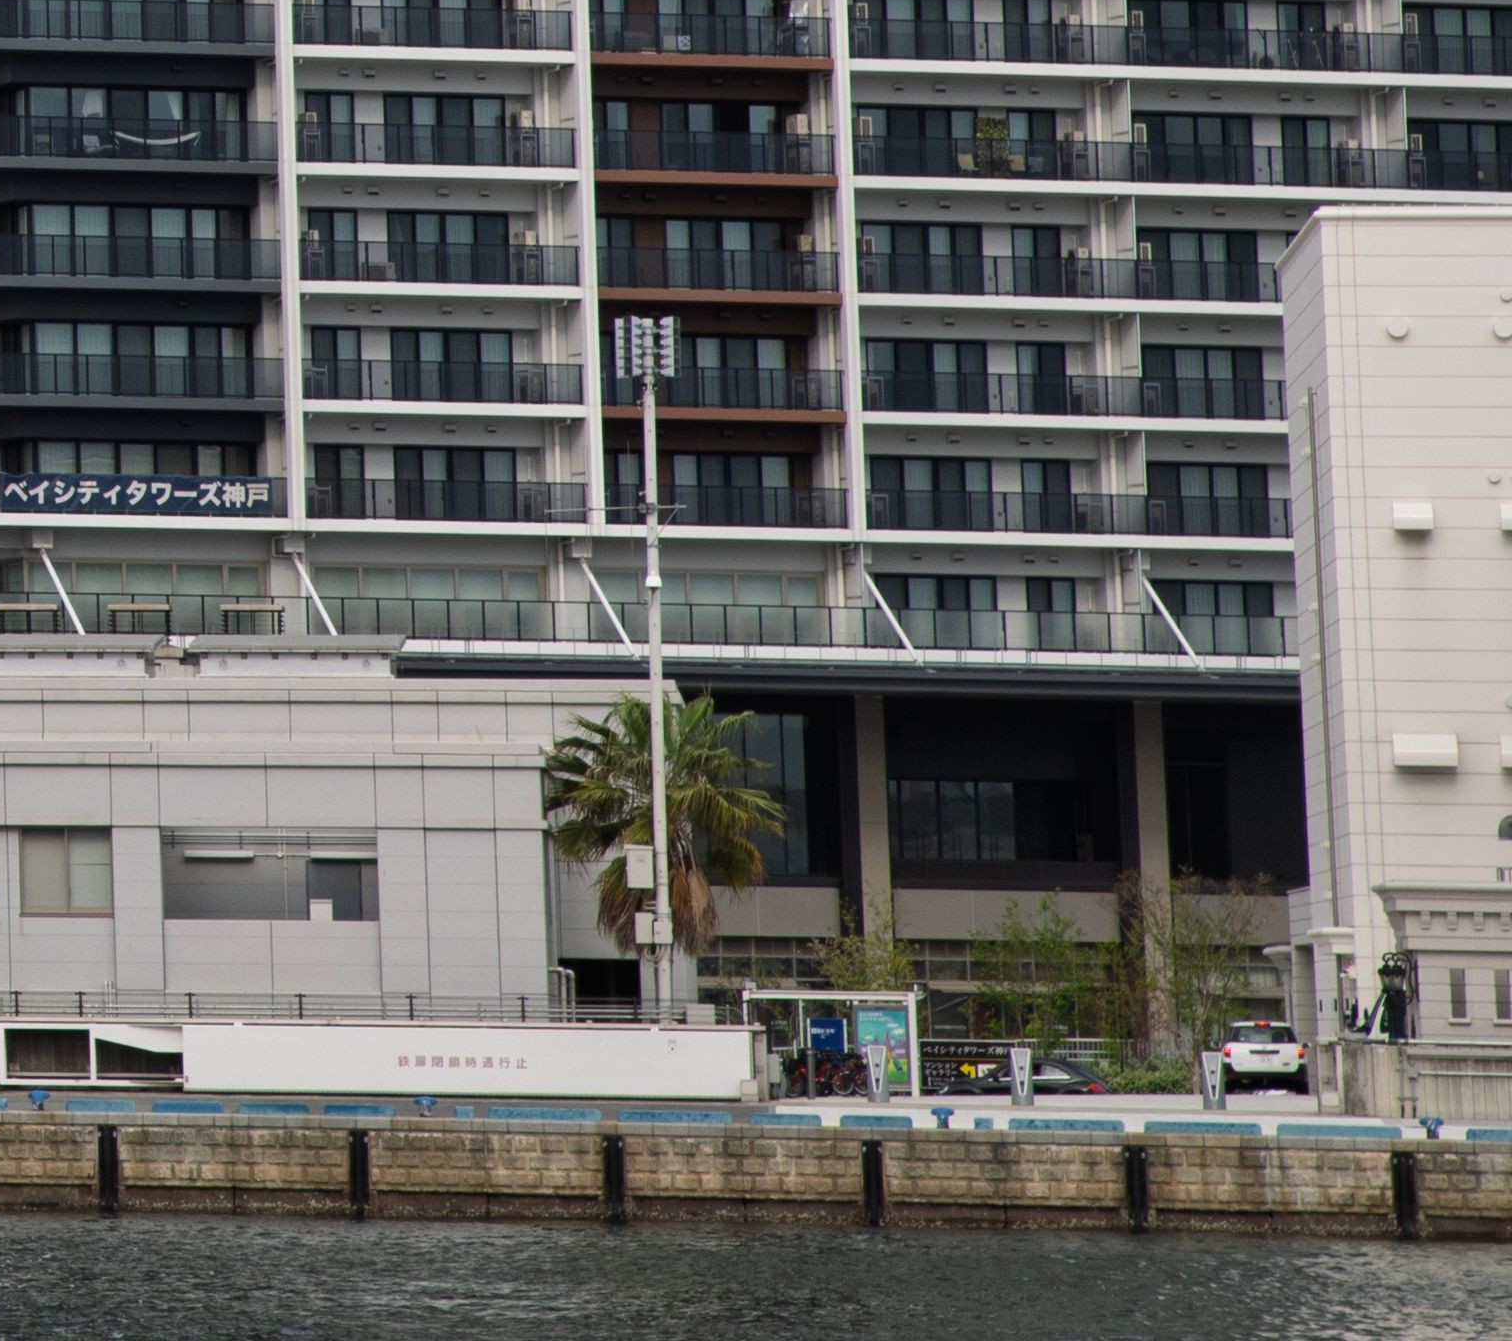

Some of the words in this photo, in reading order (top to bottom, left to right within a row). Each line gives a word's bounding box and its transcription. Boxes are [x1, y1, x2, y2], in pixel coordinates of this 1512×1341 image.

[4, 479, 269, 509] ベイシティタワーズ神戸
